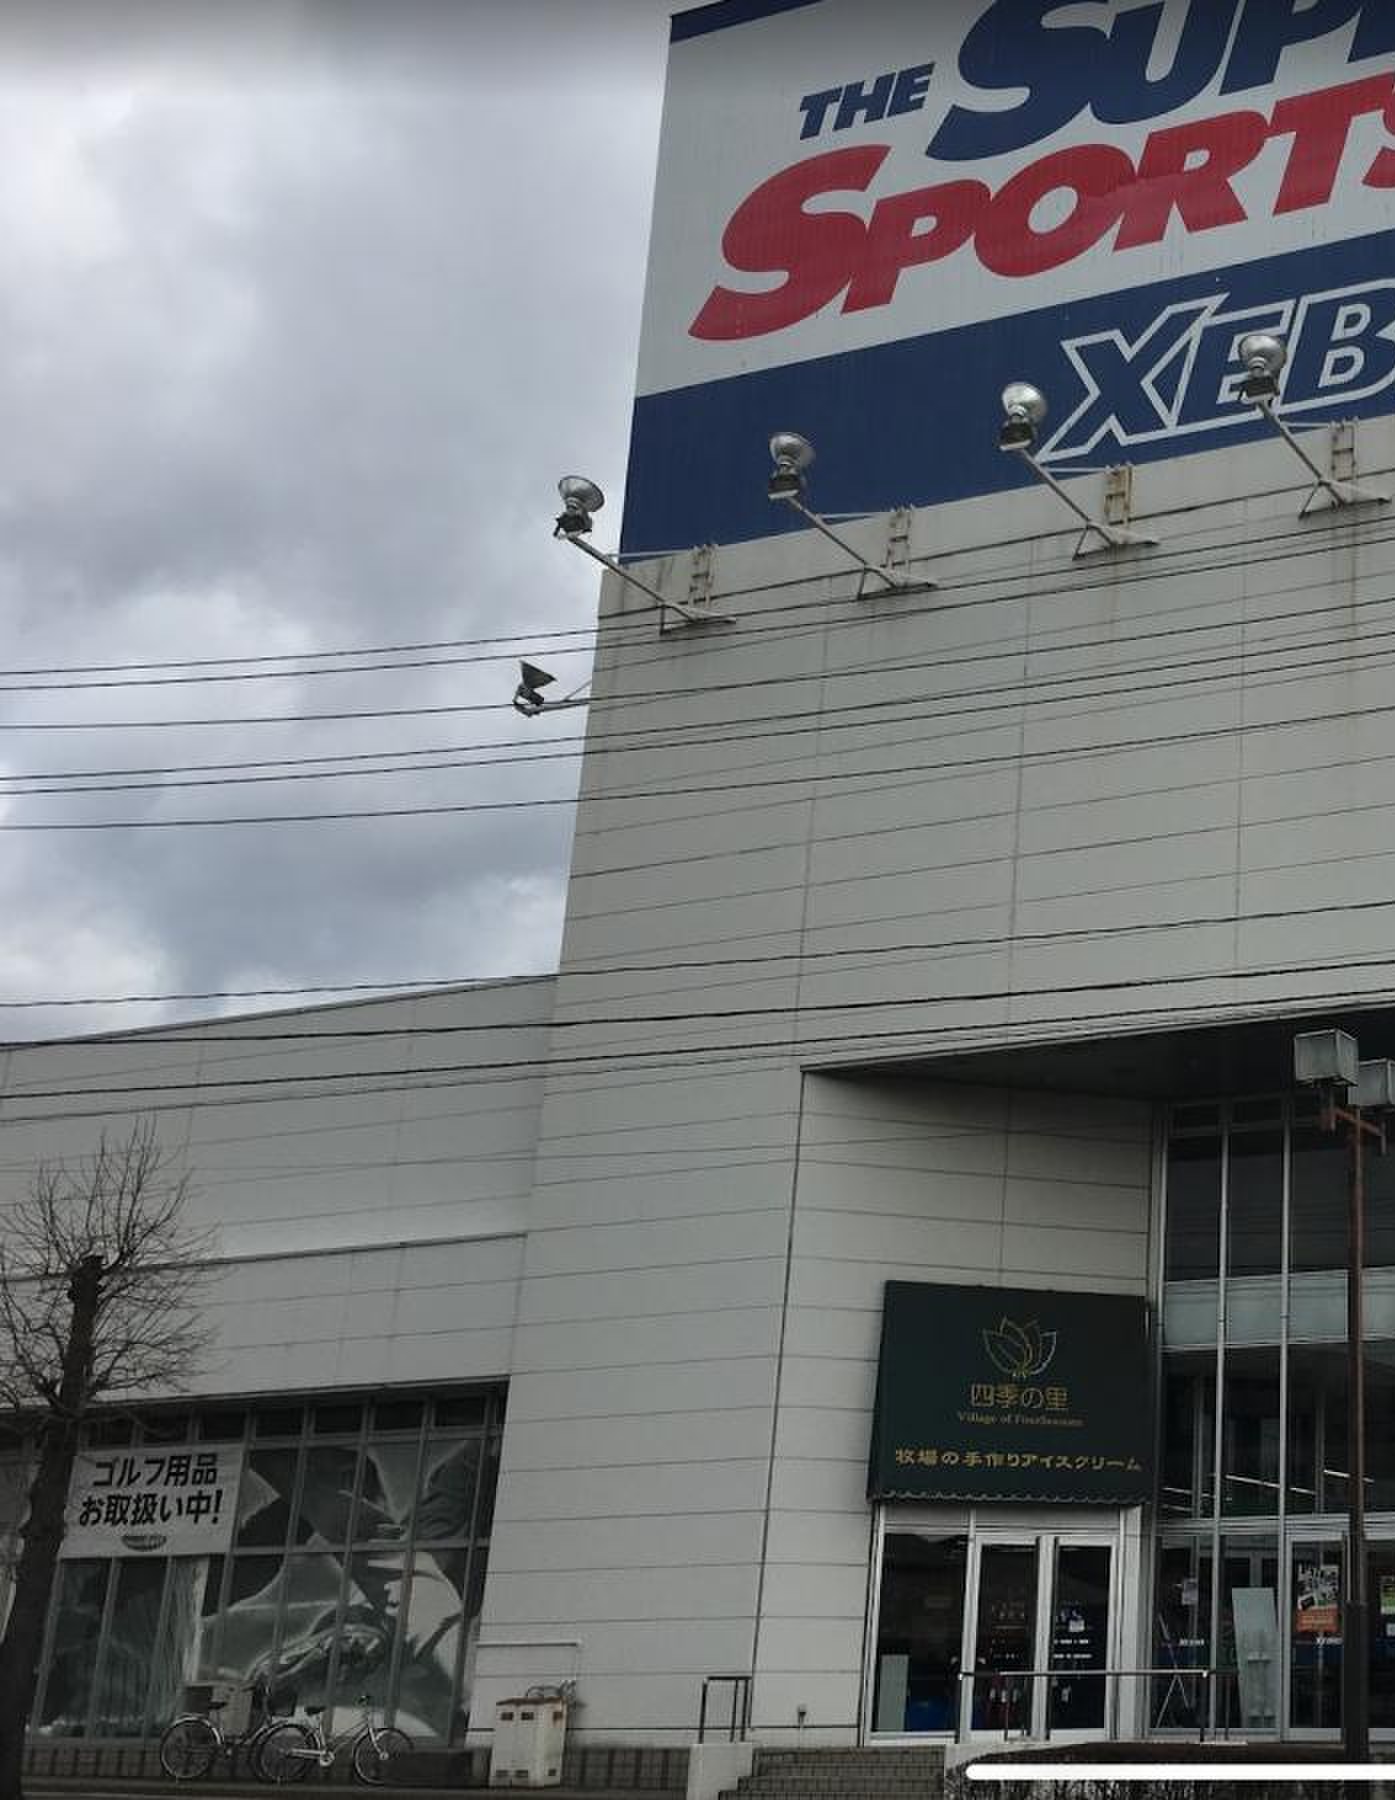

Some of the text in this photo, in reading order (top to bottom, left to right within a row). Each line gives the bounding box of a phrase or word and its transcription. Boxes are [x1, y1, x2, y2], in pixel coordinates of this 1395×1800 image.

[799, 61, 935, 140] THE
[969, 1384, 1070, 1411] 四季の里
[92, 1453, 218, 1487] ゴルフ用品
[895, 1448, 1142, 1472] 牧場の手作りアイスクリーム
